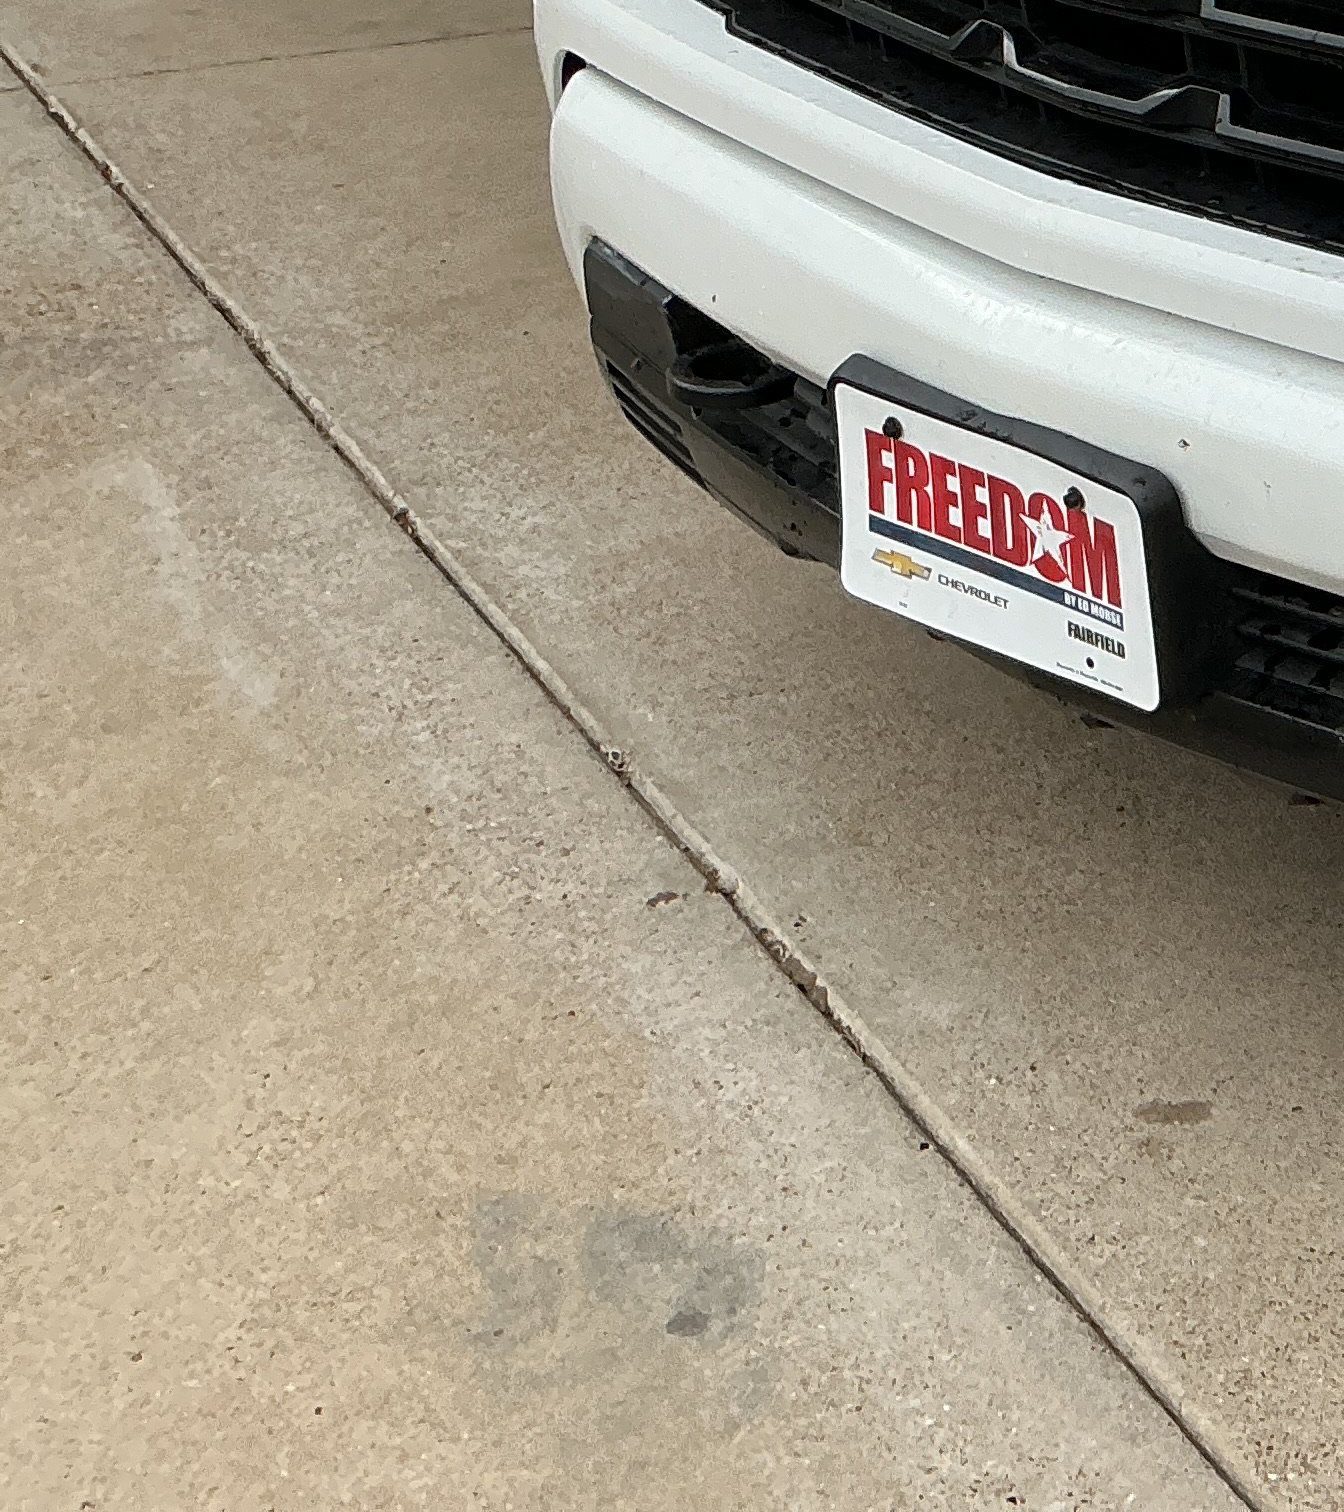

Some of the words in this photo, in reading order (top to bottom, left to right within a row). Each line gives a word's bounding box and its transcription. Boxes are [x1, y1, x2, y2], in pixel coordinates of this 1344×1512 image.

[864, 428, 1123, 609] FREEDOM
[937, 573, 1010, 609] CHEVROLET
[1067, 620, 1126, 659] FAIRFIELD
